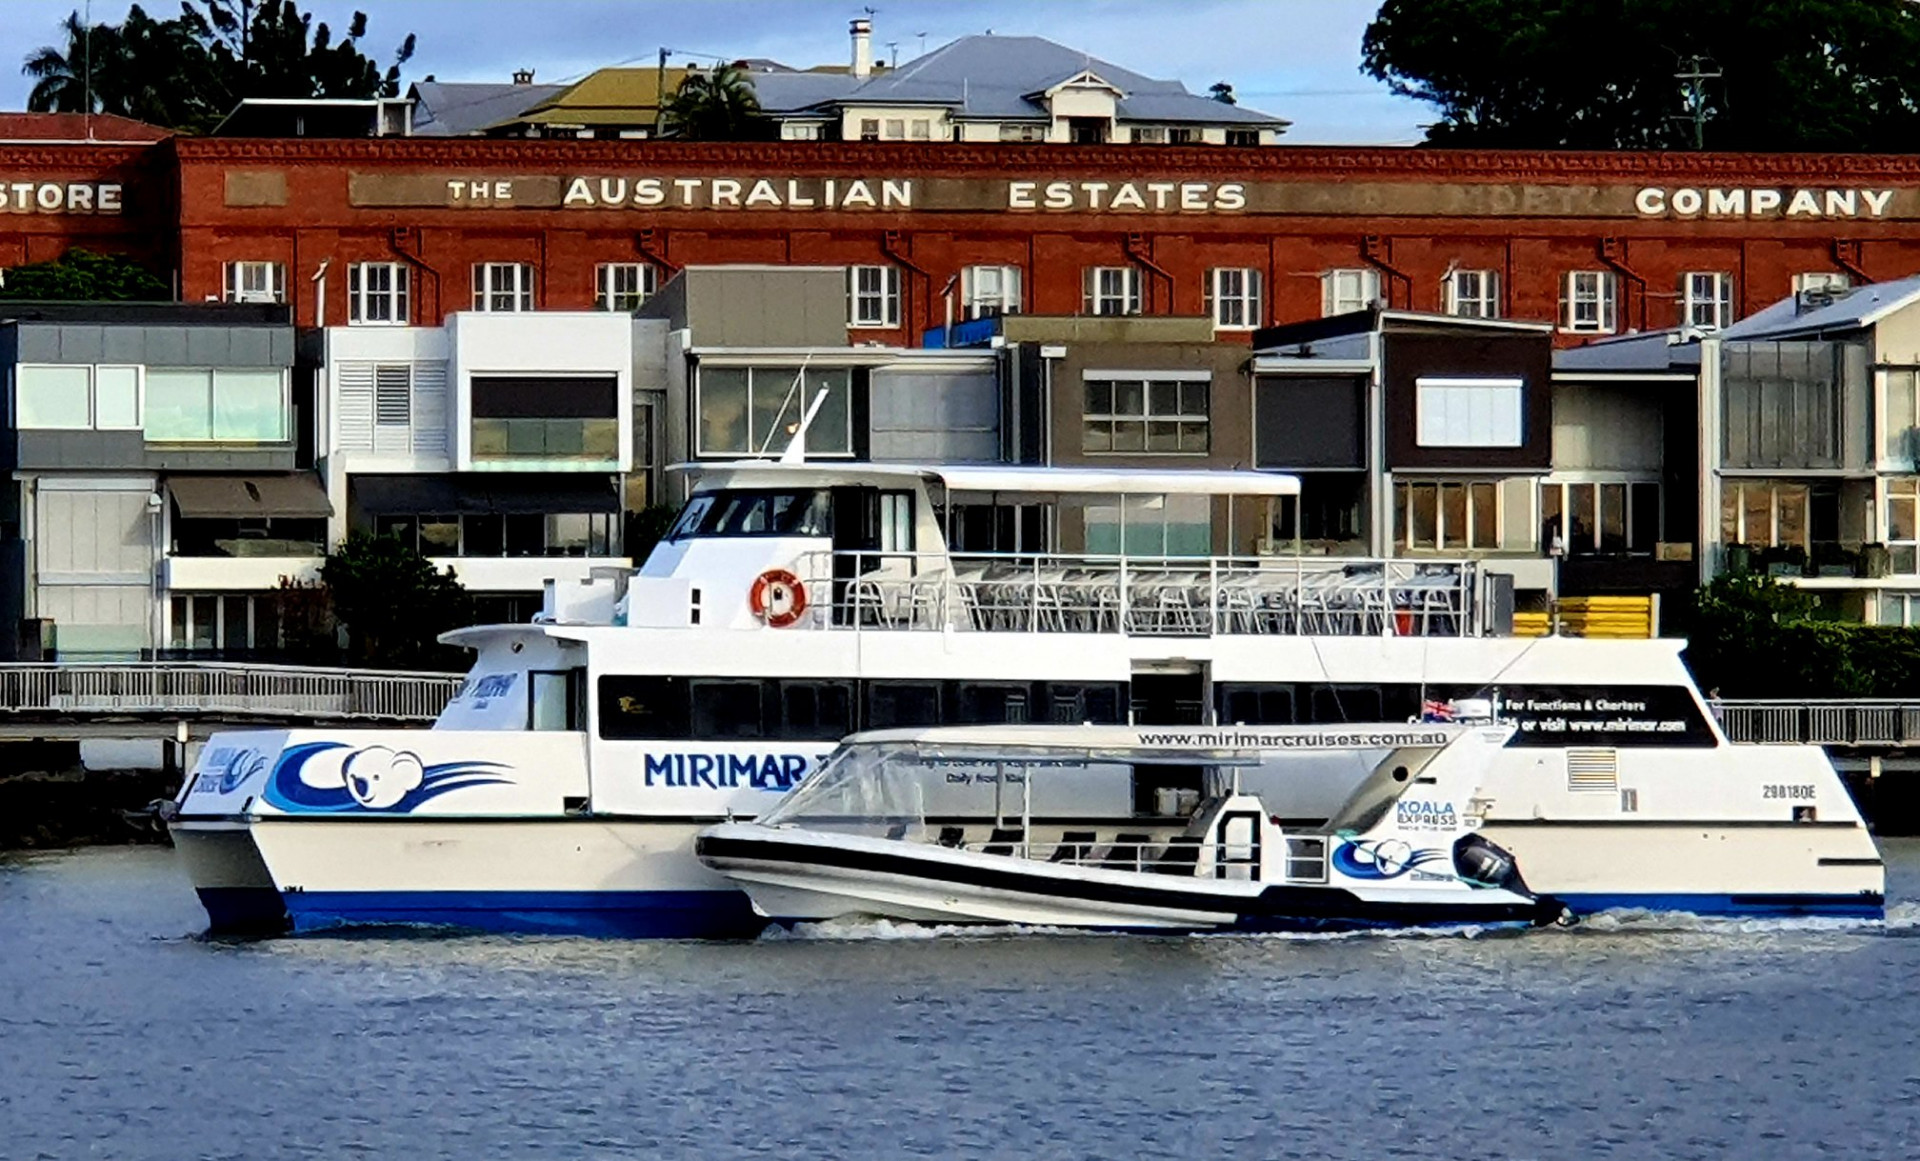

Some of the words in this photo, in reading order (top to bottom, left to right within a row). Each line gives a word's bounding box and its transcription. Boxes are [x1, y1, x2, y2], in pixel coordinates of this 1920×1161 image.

[448, 181, 512, 199] THE
[563, 178, 912, 208] AUSTRALIAN
[1008, 181, 1246, 210] ESTATES
[1635, 187, 1893, 217] COMPANY
[1506, 699, 1524, 710] For
[1527, 699, 1581, 711] Functions
[1595, 699, 1646, 711] Charters
[1521, 720, 1537, 731] or
[1540, 716, 1567, 731] visit
[1138, 732, 1447, 746] www.mirimarcruises.com.au
[644, 754, 807, 789] MIRIMAR
[1398, 801, 1455, 814] KOALA
[1397, 813, 1458, 826] EXPRESS
